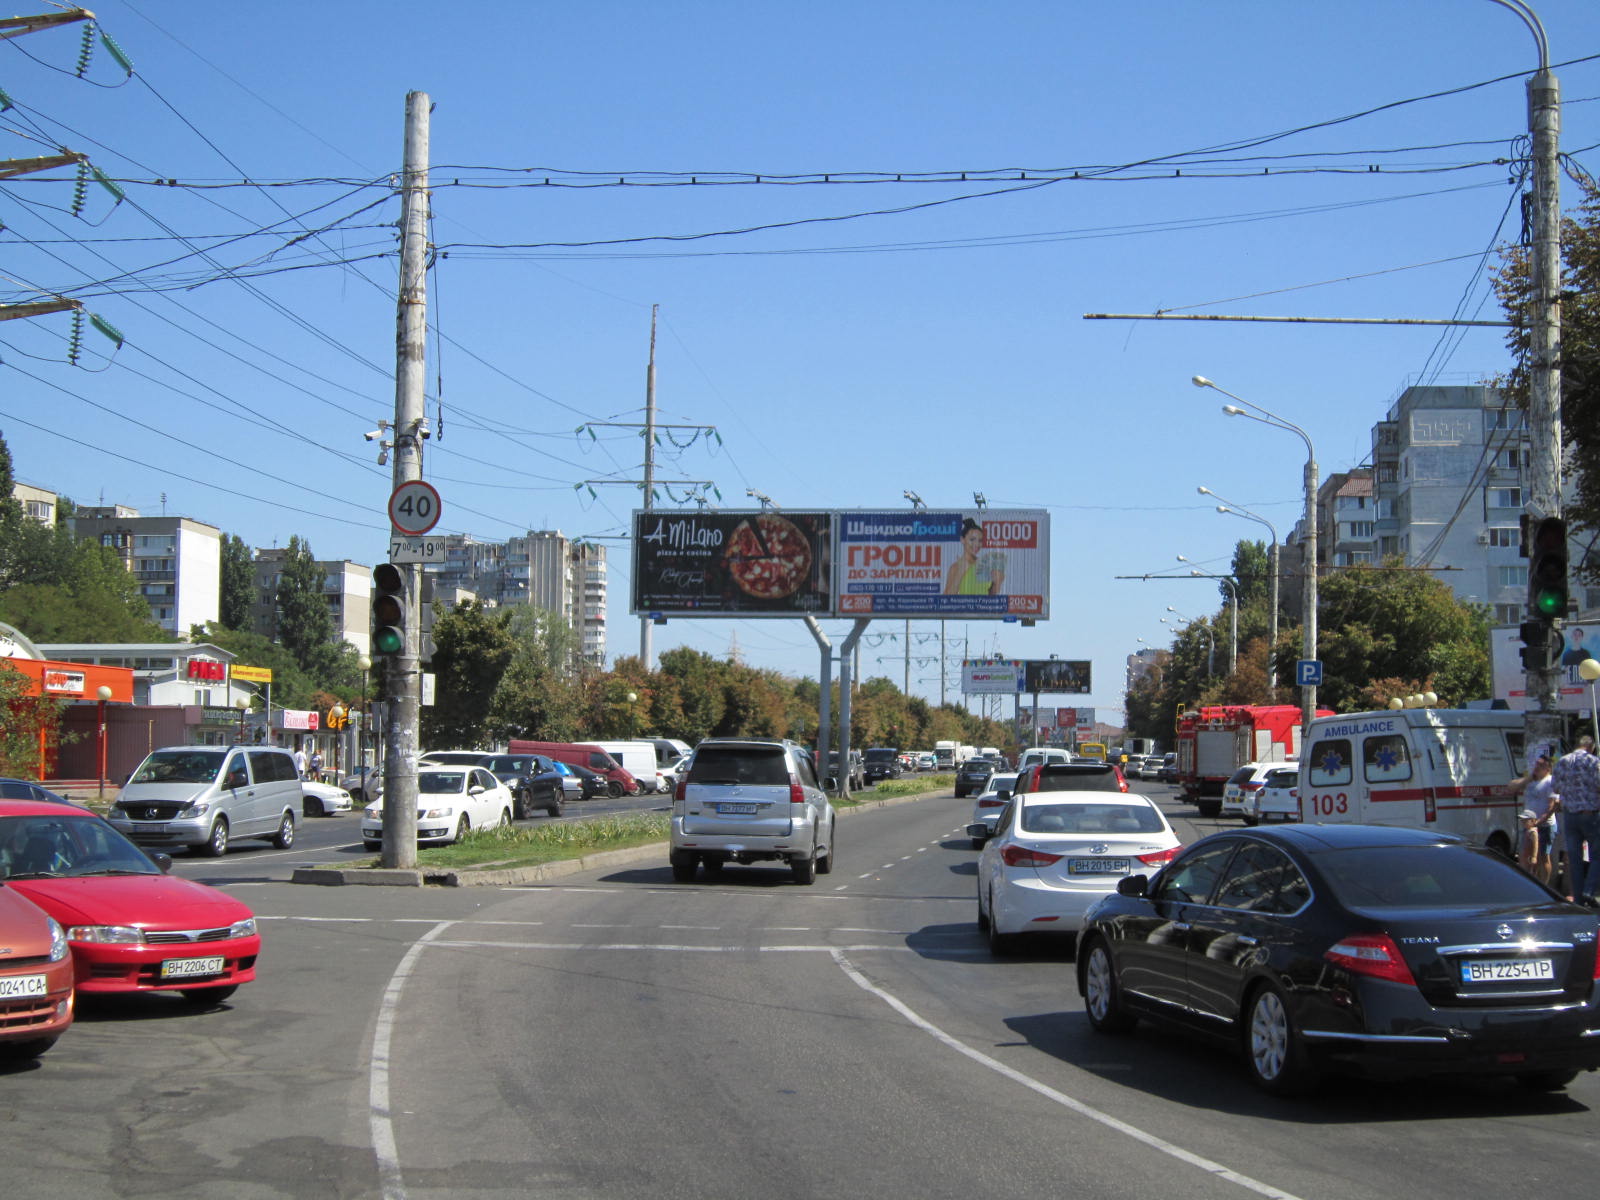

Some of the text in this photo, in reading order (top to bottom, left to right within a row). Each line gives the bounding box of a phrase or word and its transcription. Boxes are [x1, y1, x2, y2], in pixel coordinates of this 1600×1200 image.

[398, 495, 431, 517] 40
[643, 519, 667, 545] A
[847, 545, 941, 567] ГРОШІ
[848, 569, 941, 579] ДО ЗАРПЛАТИ
[1303, 664, 1316, 681] P
[1324, 720, 1394, 738] AMBULANCE
[1311, 792, 1348, 815] 103
[1400, 936, 1440, 944] TEANA
[168, 959, 221, 974] BH 2206 CT
[1471, 961, 1550, 979] BH 2254 IP
